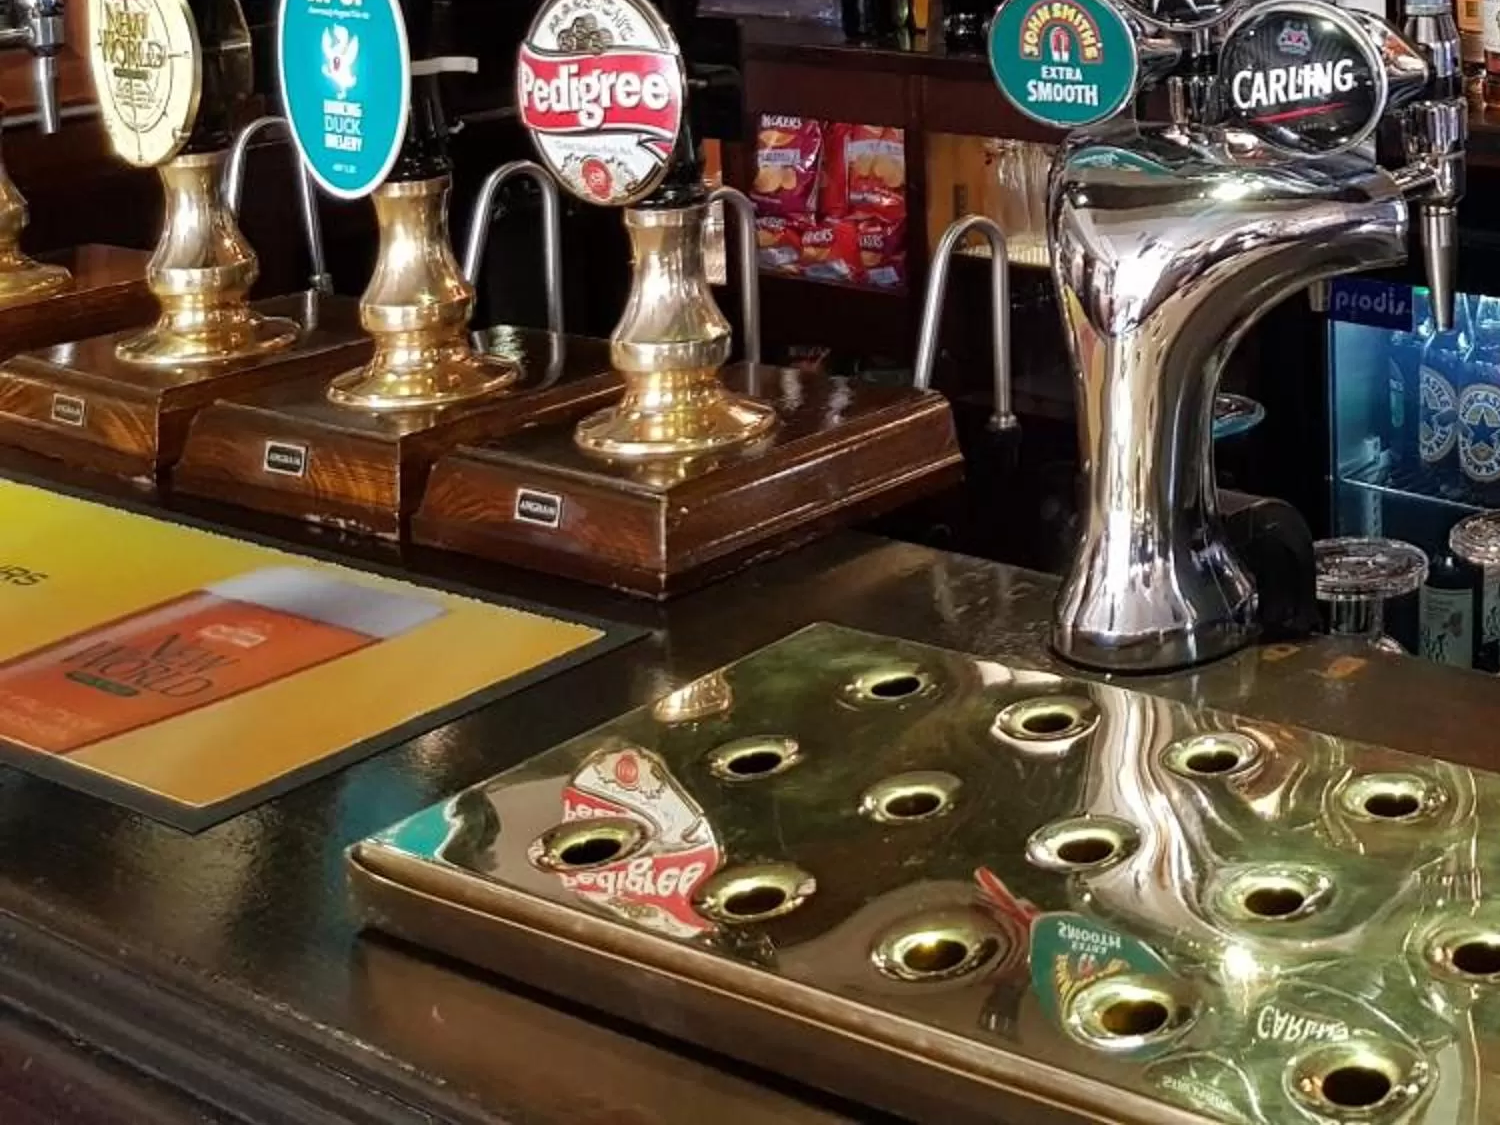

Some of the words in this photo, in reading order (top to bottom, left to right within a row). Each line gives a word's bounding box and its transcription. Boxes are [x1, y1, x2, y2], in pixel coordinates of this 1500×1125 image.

[1023, 5, 1050, 57] JOHN
[1026, 79, 1099, 107] SMOOTH
[1040, 65, 1084, 82] EXTRA
[1232, 58, 1354, 110] CARLING
[520, 61, 672, 128] Pedigree
[324, 114, 362, 136] DUCK
